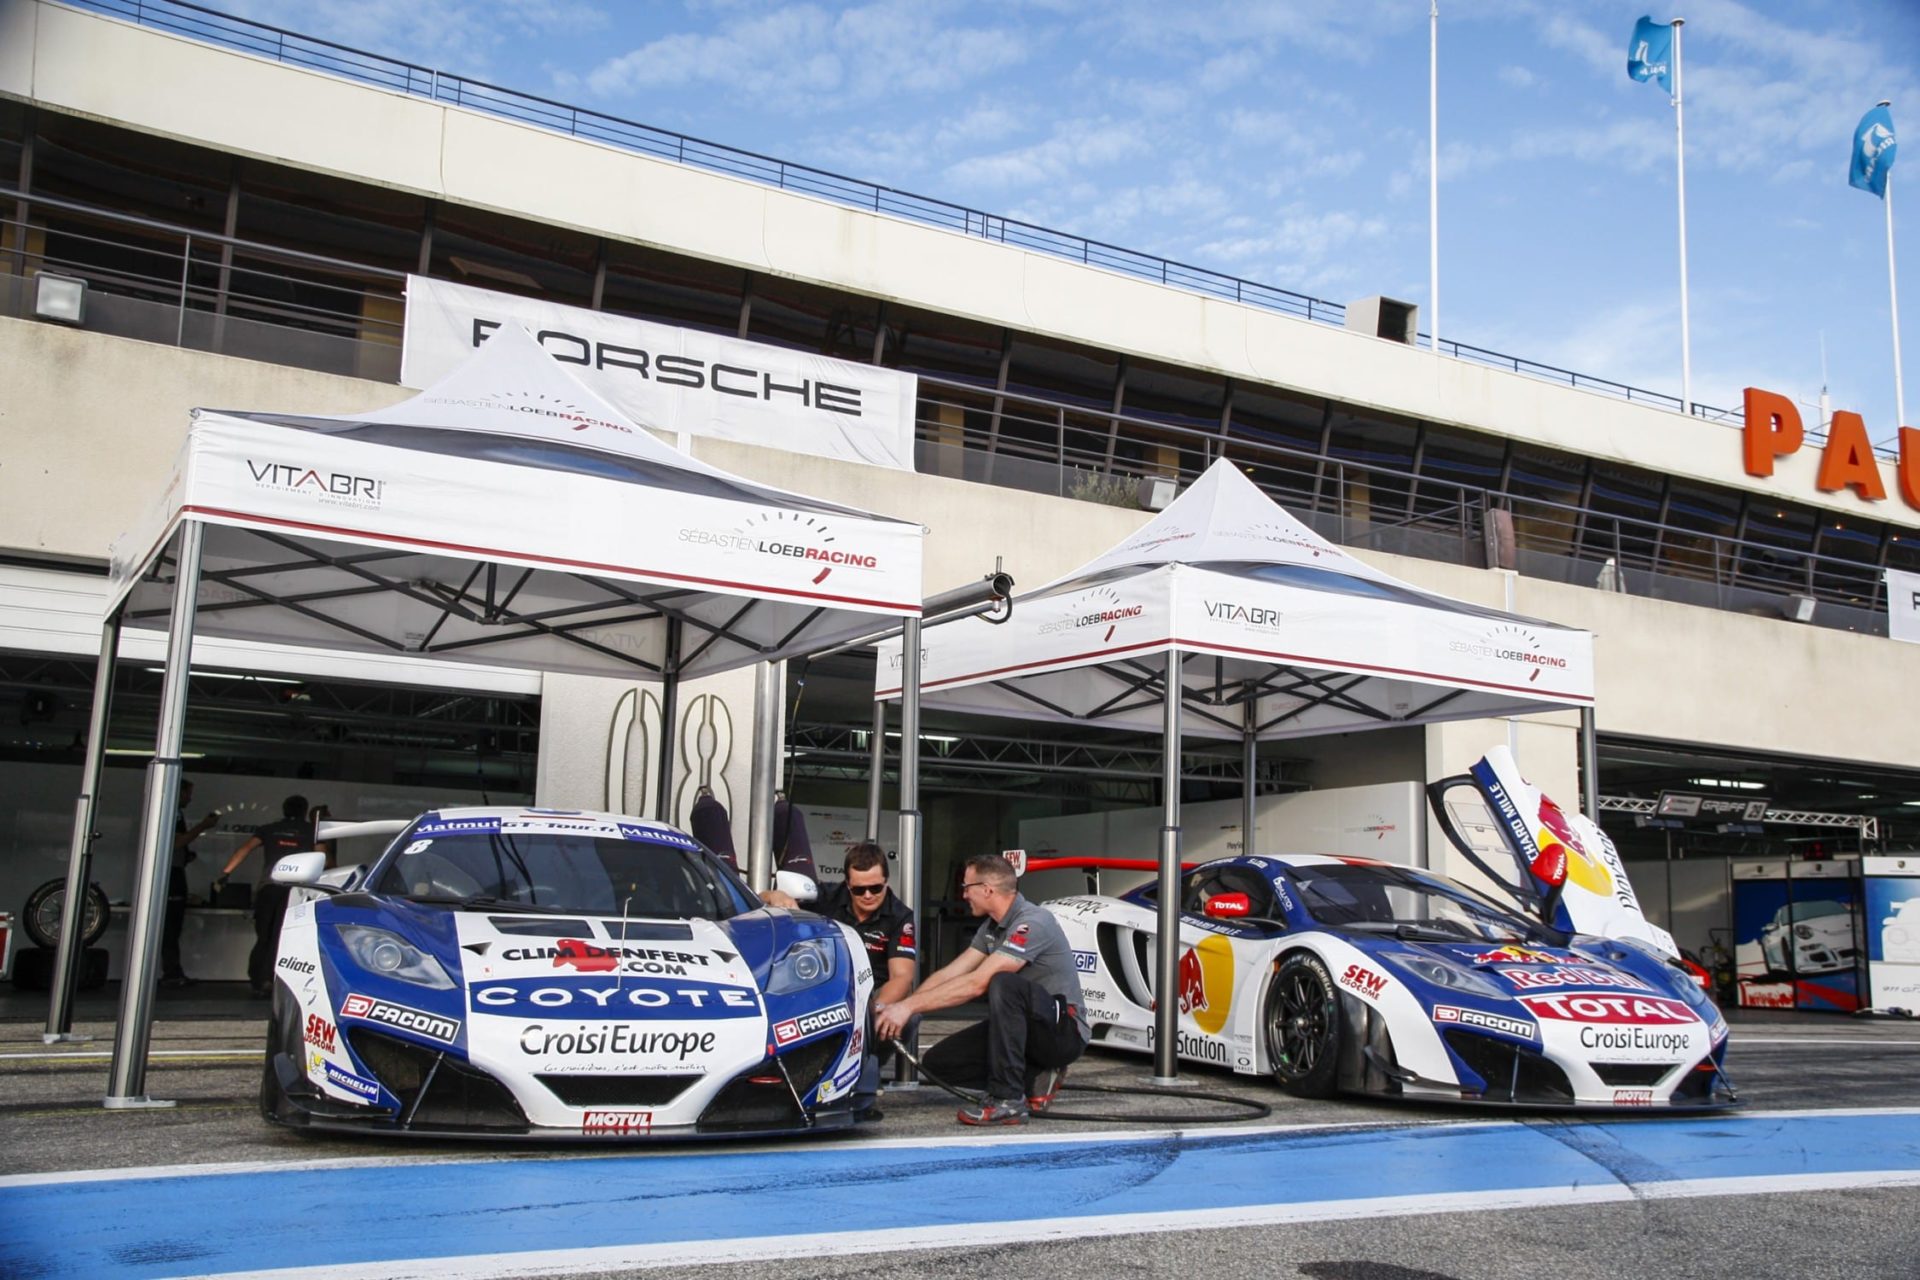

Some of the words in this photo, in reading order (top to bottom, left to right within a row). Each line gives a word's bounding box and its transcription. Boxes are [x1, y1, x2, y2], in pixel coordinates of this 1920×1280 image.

[403, 839, 434, 855] 8
[819, 865, 845, 874] TOTA
[1552, 852, 1567, 880] TOTAL
[1214, 901, 1244, 911] TOTAL
[1343, 964, 1388, 992] SEW
[476, 986, 756, 1008] COYOTE
[1529, 995, 1696, 1022] TOTAL
[305, 1013, 337, 1043] SEW
[370, 1004, 455, 1039] FACOM
[800, 1006, 851, 1034] FACOM
[1461, 1010, 1534, 1039] FACOM
[519, 1024, 716, 1061] CroisiEurope
[1580, 1026, 1690, 1054] CroisiEurope
[328, 1067, 379, 1096] MICHELIN
[584, 1112, 651, 1127] MOTUL
